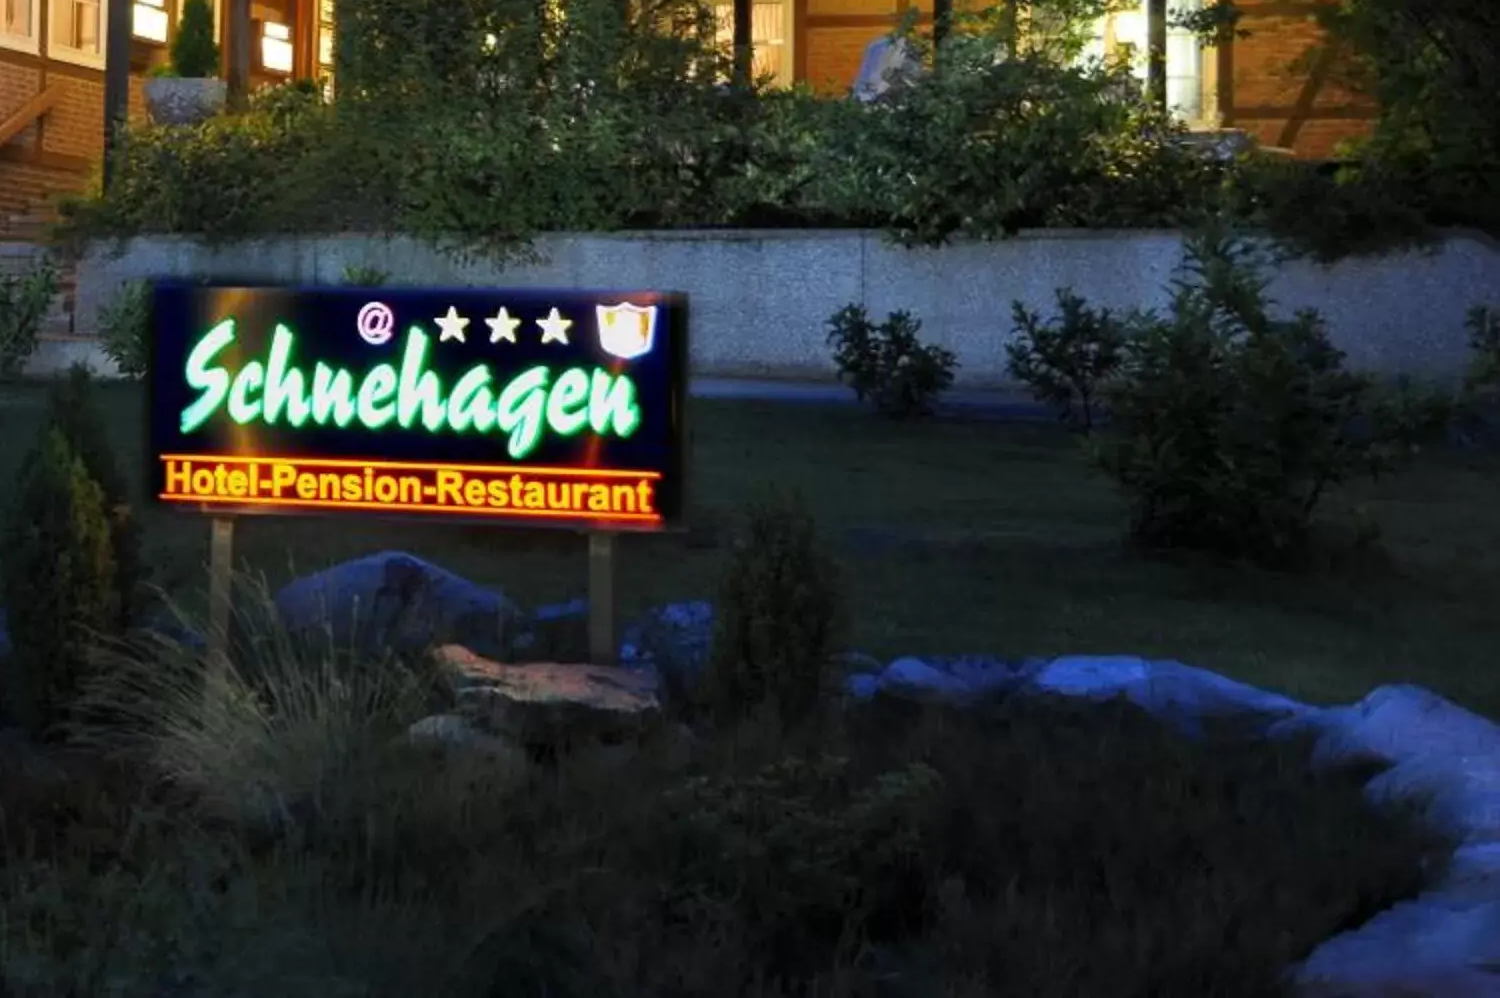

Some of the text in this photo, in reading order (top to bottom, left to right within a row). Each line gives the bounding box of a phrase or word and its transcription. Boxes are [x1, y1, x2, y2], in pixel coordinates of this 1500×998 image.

[356, 301, 395, 345] @
[179, 318, 640, 459] Schnehagen
[164, 460, 653, 513] Hotel-Pension-Restaurant
